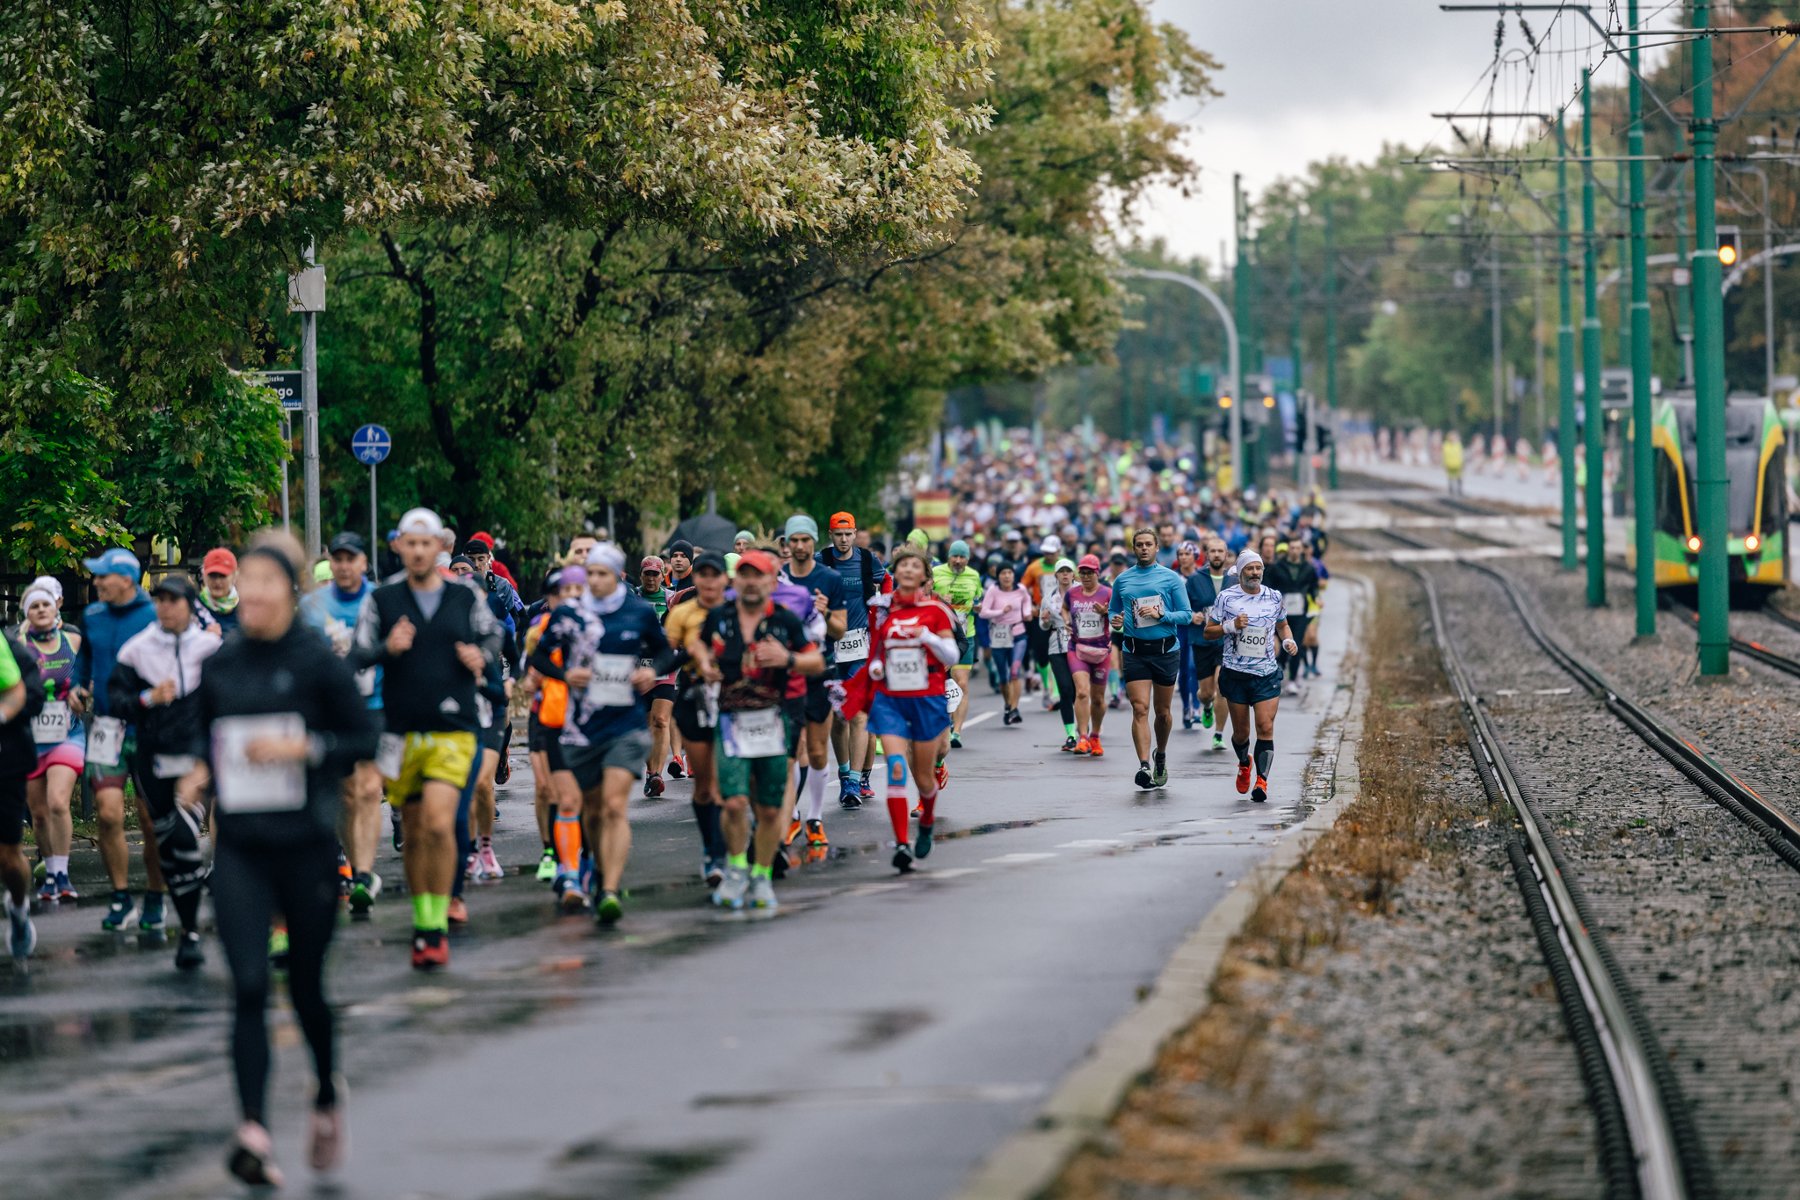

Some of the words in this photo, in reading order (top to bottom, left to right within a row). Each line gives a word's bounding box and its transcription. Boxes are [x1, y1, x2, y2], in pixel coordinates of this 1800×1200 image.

[840, 639, 863, 650] 3381
[1240, 635, 1266, 645] 4500
[37, 714, 64, 727] 1072
